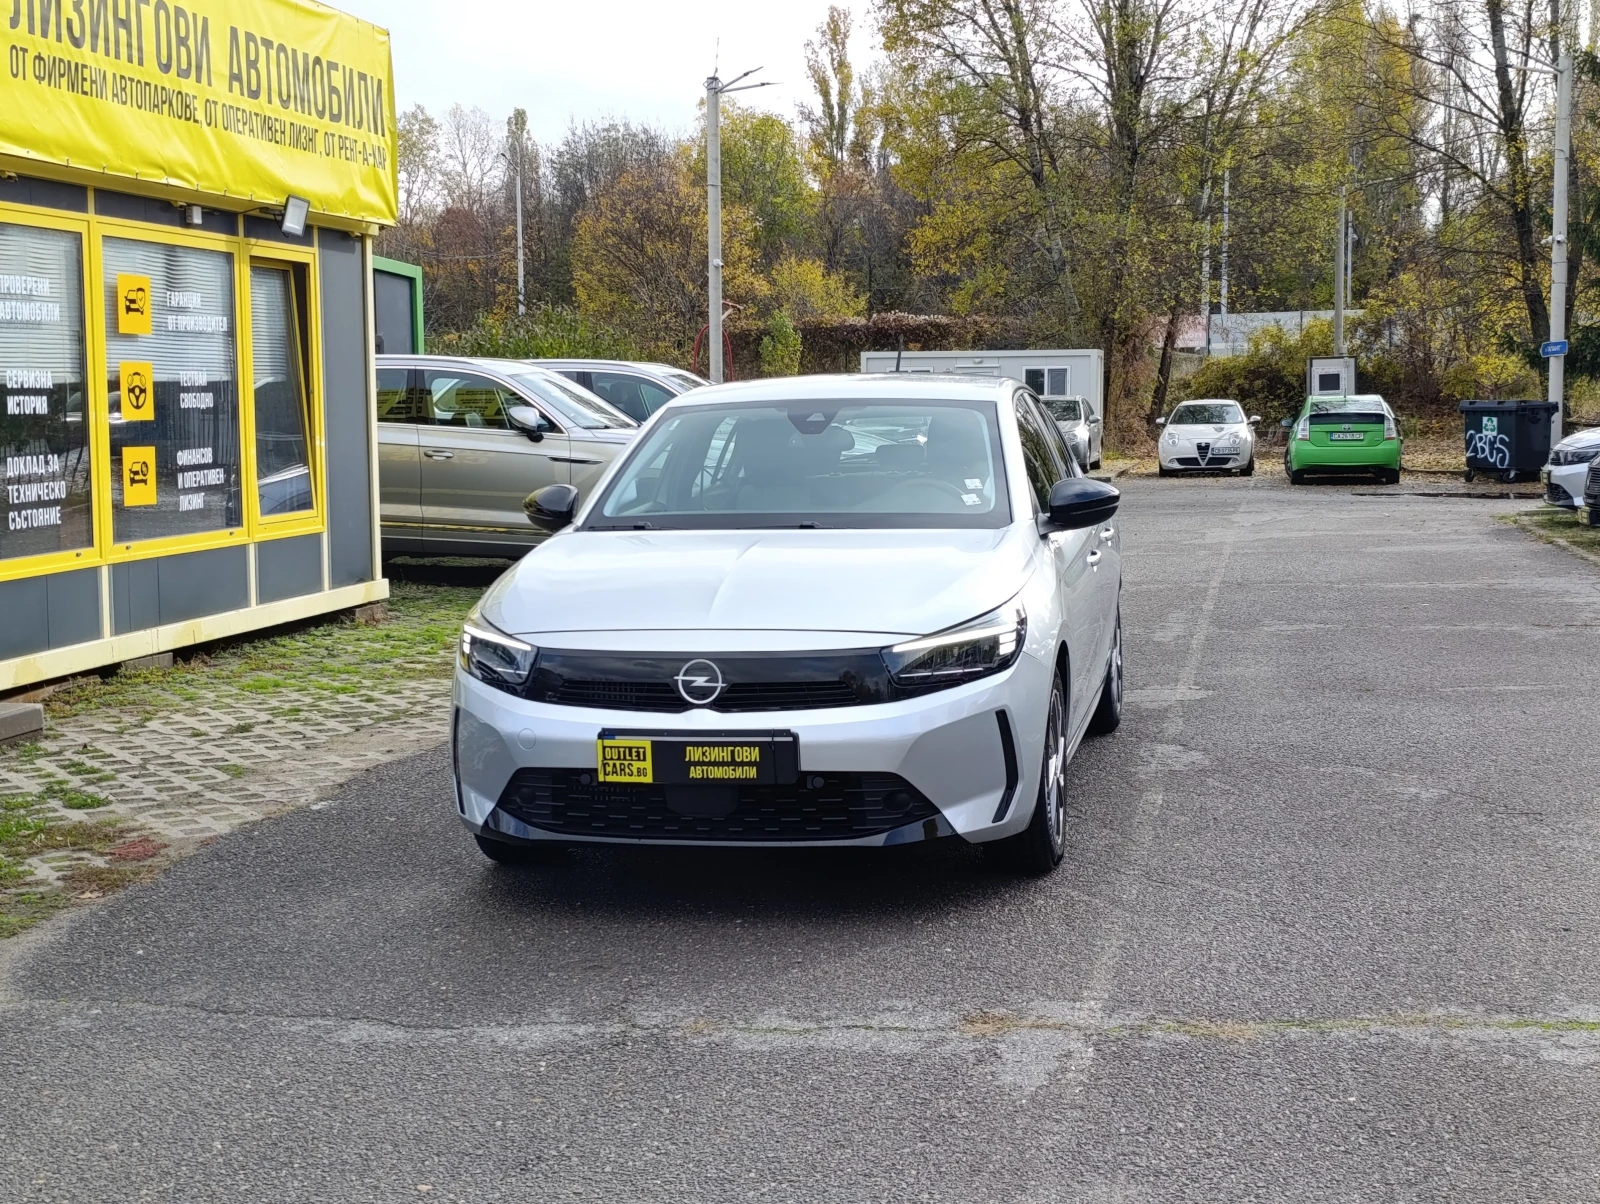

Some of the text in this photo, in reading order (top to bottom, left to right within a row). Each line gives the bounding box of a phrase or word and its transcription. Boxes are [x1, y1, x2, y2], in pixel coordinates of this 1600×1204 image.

[228, 25, 386, 138] АВТОМОБИЛИ
[9, 44, 29, 81] ОТ
[33, 51, 108, 101] ФИРМЕНИ
[112, 72, 203, 128] АВТОПАРКОВЕ,
[205, 98, 218, 129] ОТ
[222, 102, 286, 147] ОПЕРАТИВЕН
[324, 131, 336, 160] ОТ
[338, 134, 387, 171] РЕНТ-А-КАР
[166, 291, 201, 309] ГАРАНЦИЯ
[0, 301, 60, 321] АВТОМОБИЛИ
[167, 315, 228, 332] ОТ ПРОИЗВОДИТЕЛ
[6, 370, 53, 389] СЕРВИЗНА
[179, 368, 208, 387] ТЕСТВАЙ
[7, 395, 48, 415] ИСТОРИЯ
[180, 392, 214, 409] СВОБОДНО
[6, 454, 60, 478] ДОКЛАД ЗА
[176, 447, 213, 466] ФИНАНСОВ
[177, 467, 225, 489] И ОПЕРАТИВЕН
[7, 481, 66, 504] ТЕХНИЧЕСКО
[179, 492, 205, 512] ЛИЗИНГ
[8, 506, 62, 530] СЪСТОЯНИЕ
[605, 747, 645, 760] OUTLET
[685, 746, 760, 762] ЛИЗИНГОВИ
[603, 762, 648, 777] CARS.BG
[689, 765, 757, 779] АВТОМОБИЛИ
